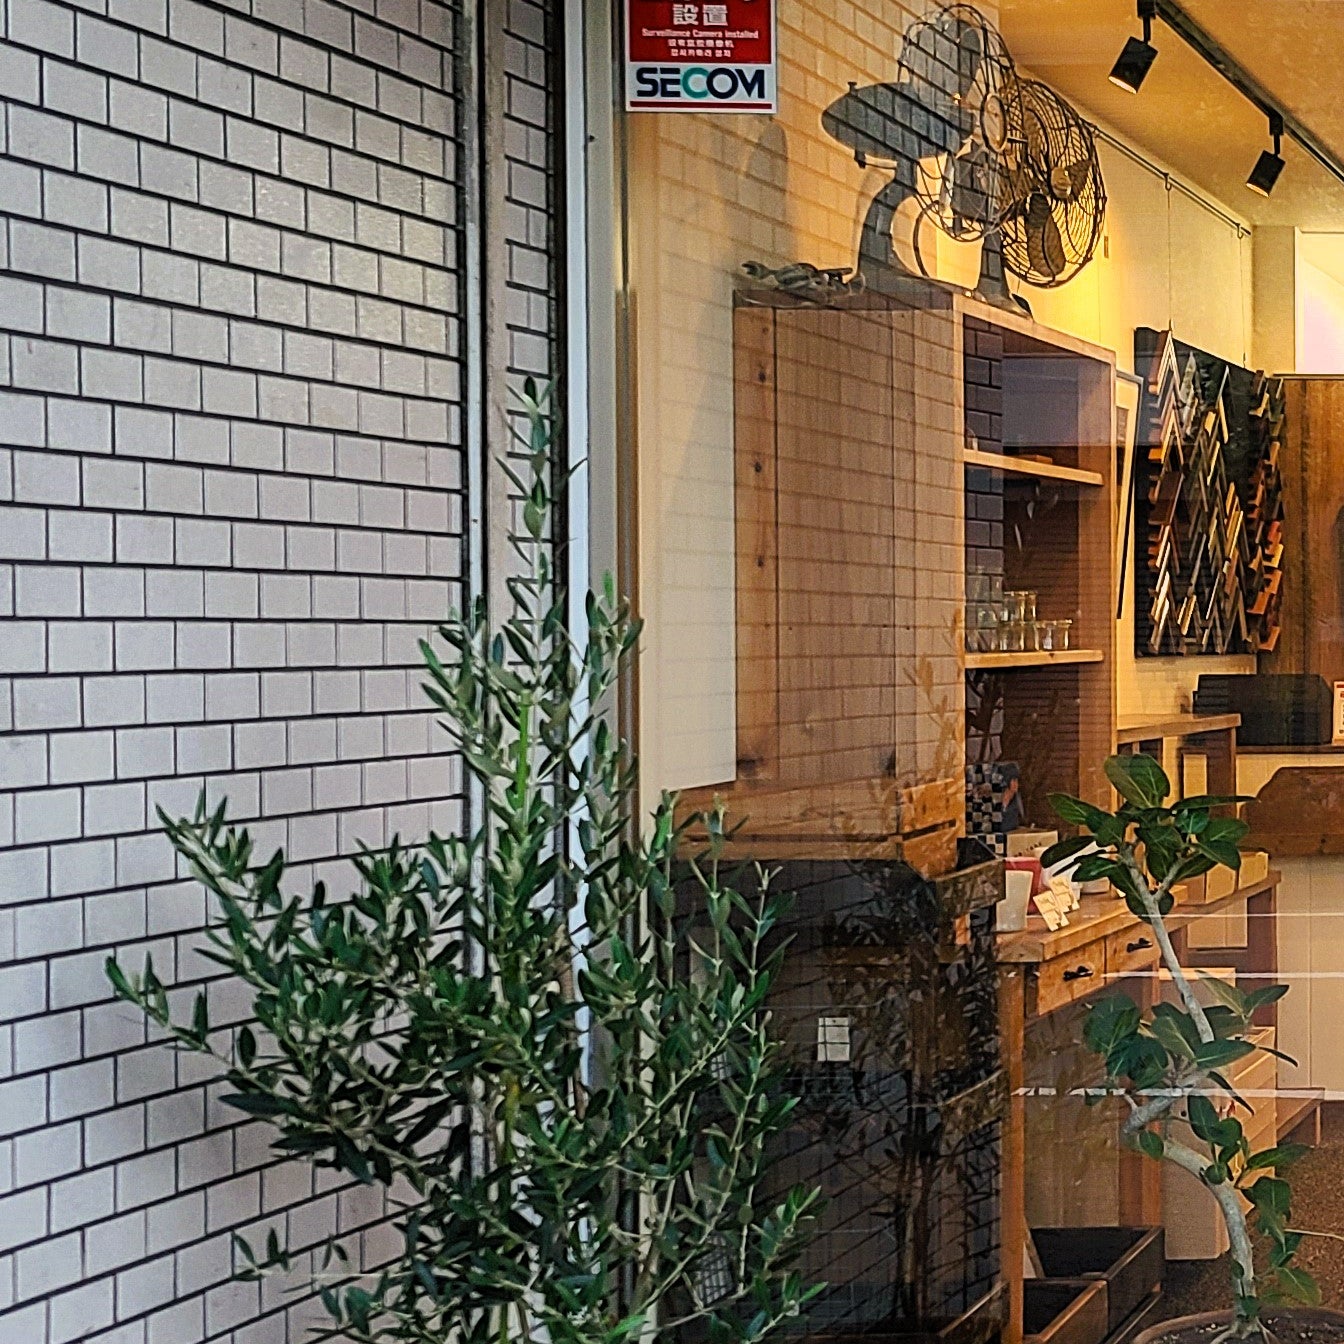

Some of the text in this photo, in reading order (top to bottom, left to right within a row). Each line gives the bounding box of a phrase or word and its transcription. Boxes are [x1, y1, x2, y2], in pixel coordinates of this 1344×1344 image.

[673, 4, 728, 26] 設置
[642, 28, 691, 38] Surveillance
[692, 29, 723, 38] Camera
[636, 67, 765, 99] SECOM
